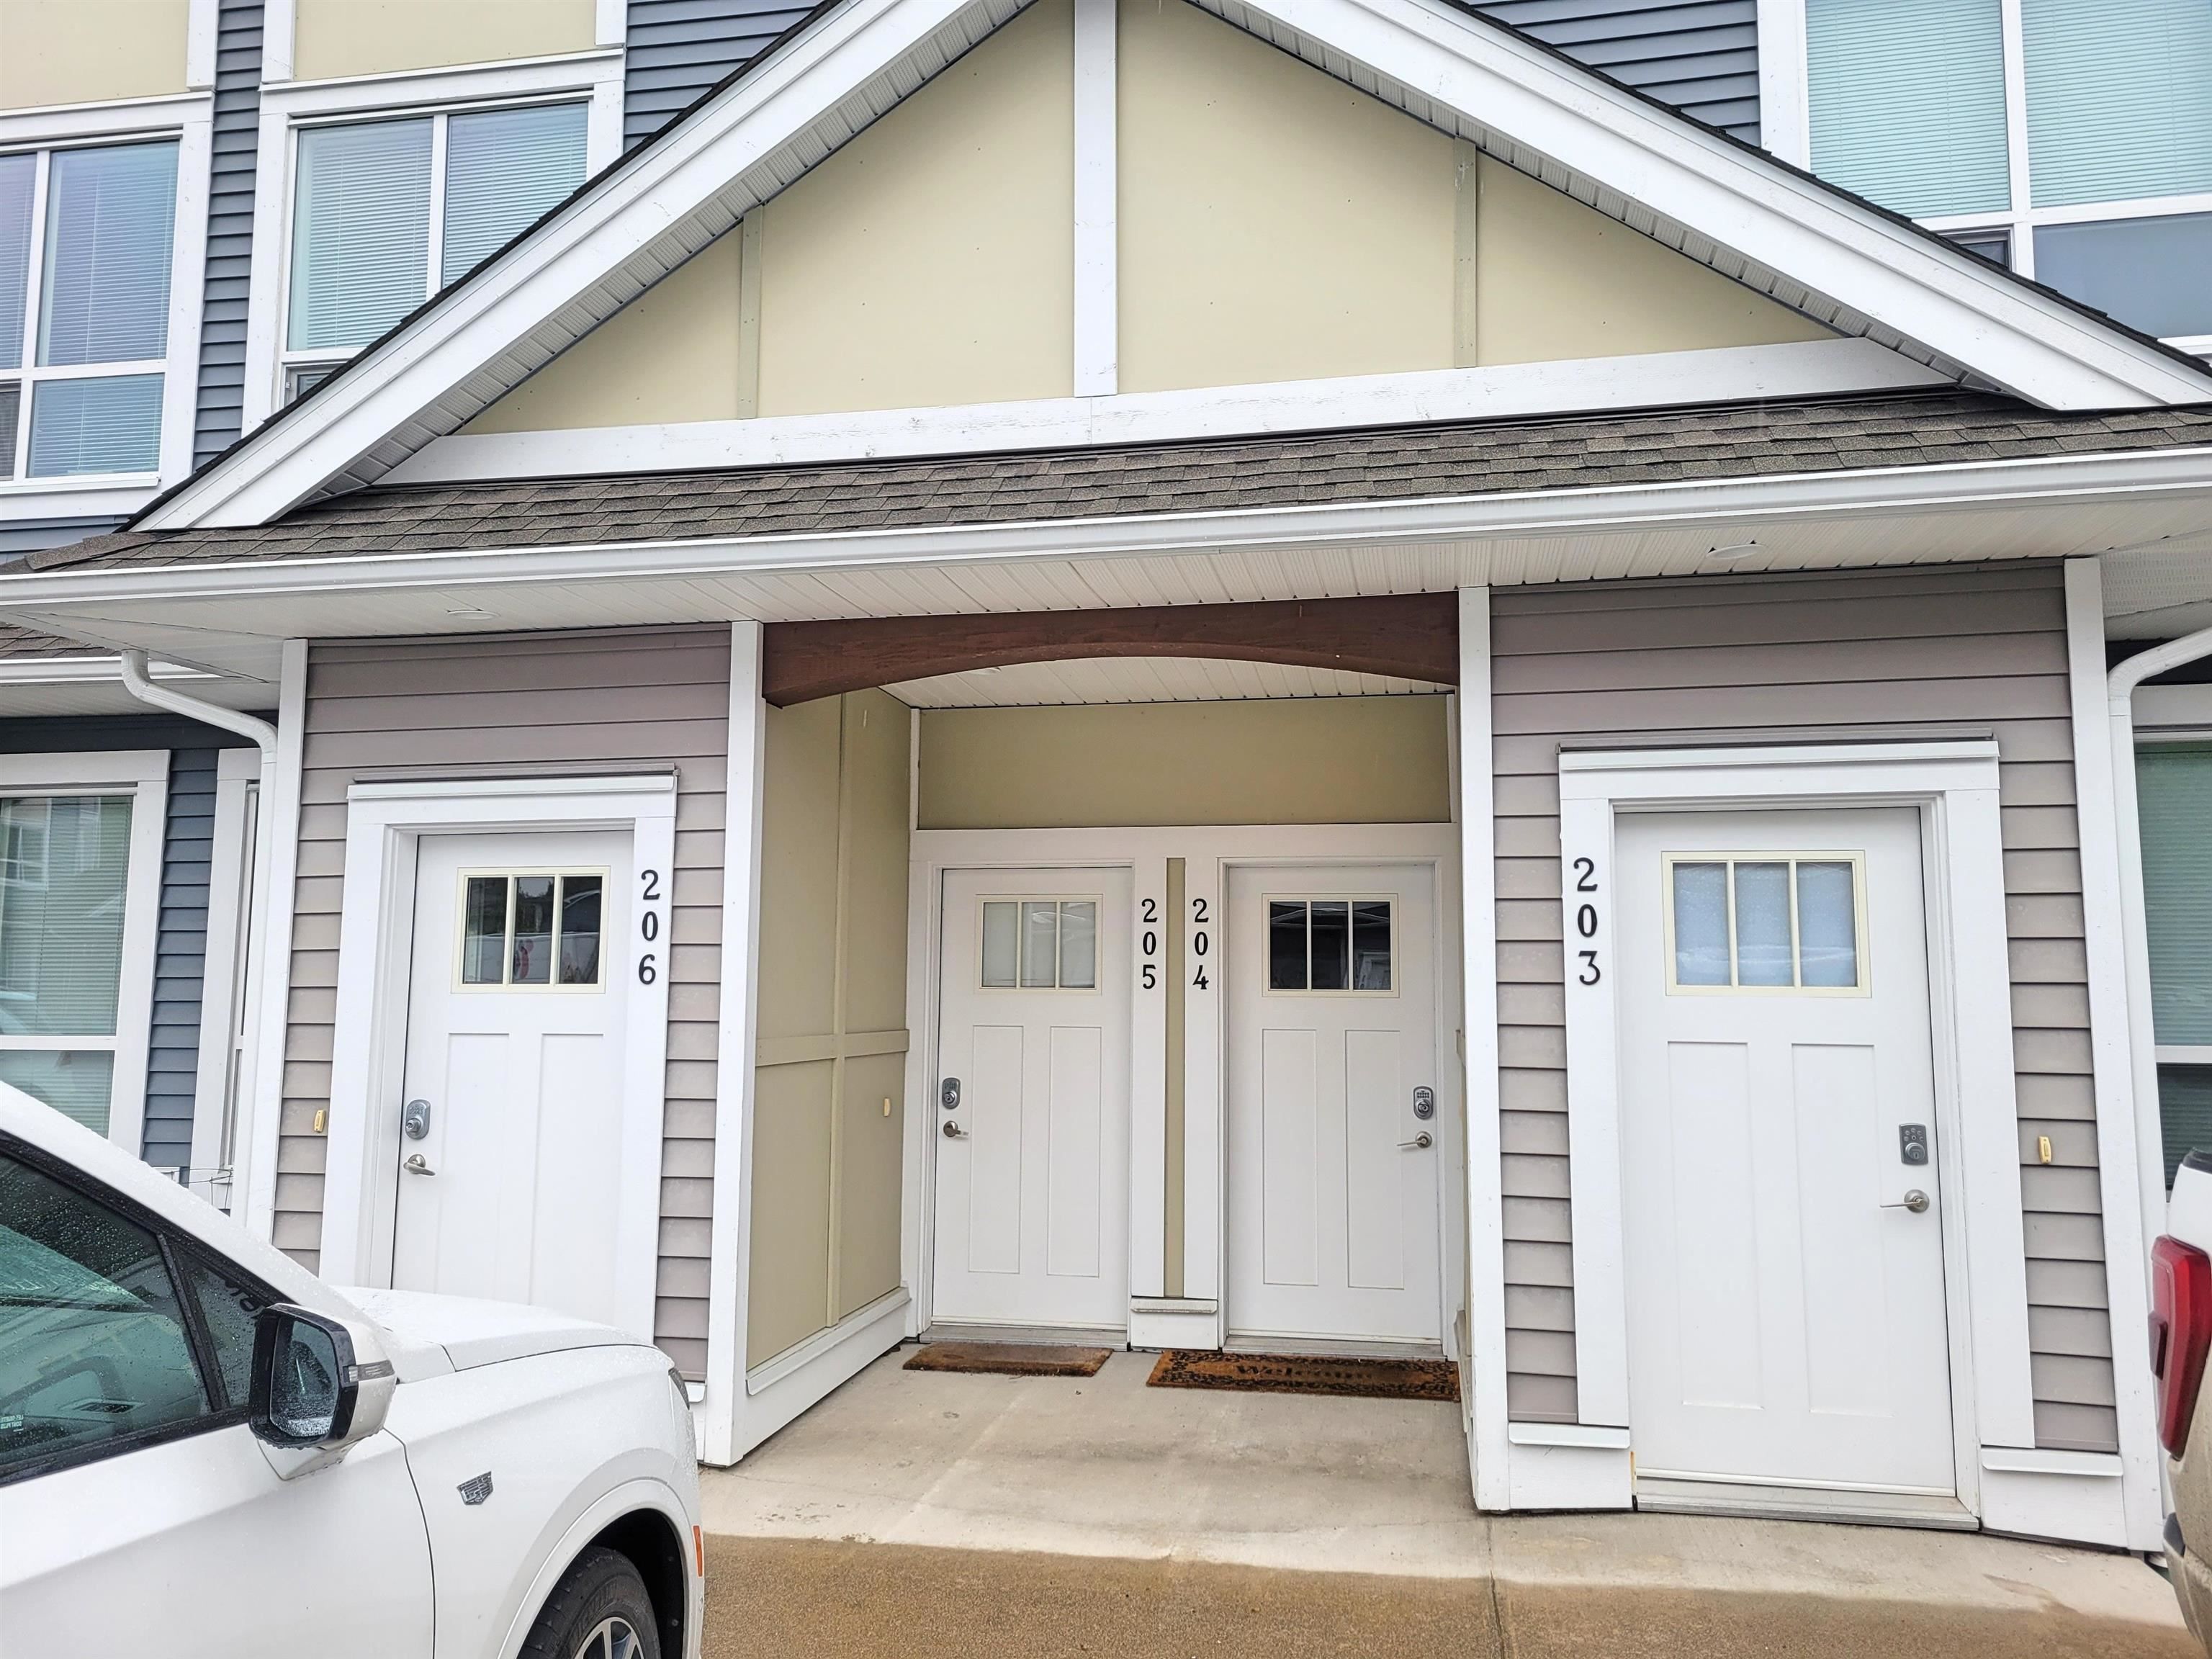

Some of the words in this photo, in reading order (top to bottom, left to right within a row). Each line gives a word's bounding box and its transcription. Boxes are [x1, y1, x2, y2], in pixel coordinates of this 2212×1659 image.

[639, 869, 660, 984] 206
[1141, 898, 1158, 989] 205
[1192, 898, 1209, 989] 204
[1573, 857, 1601, 986] 203
